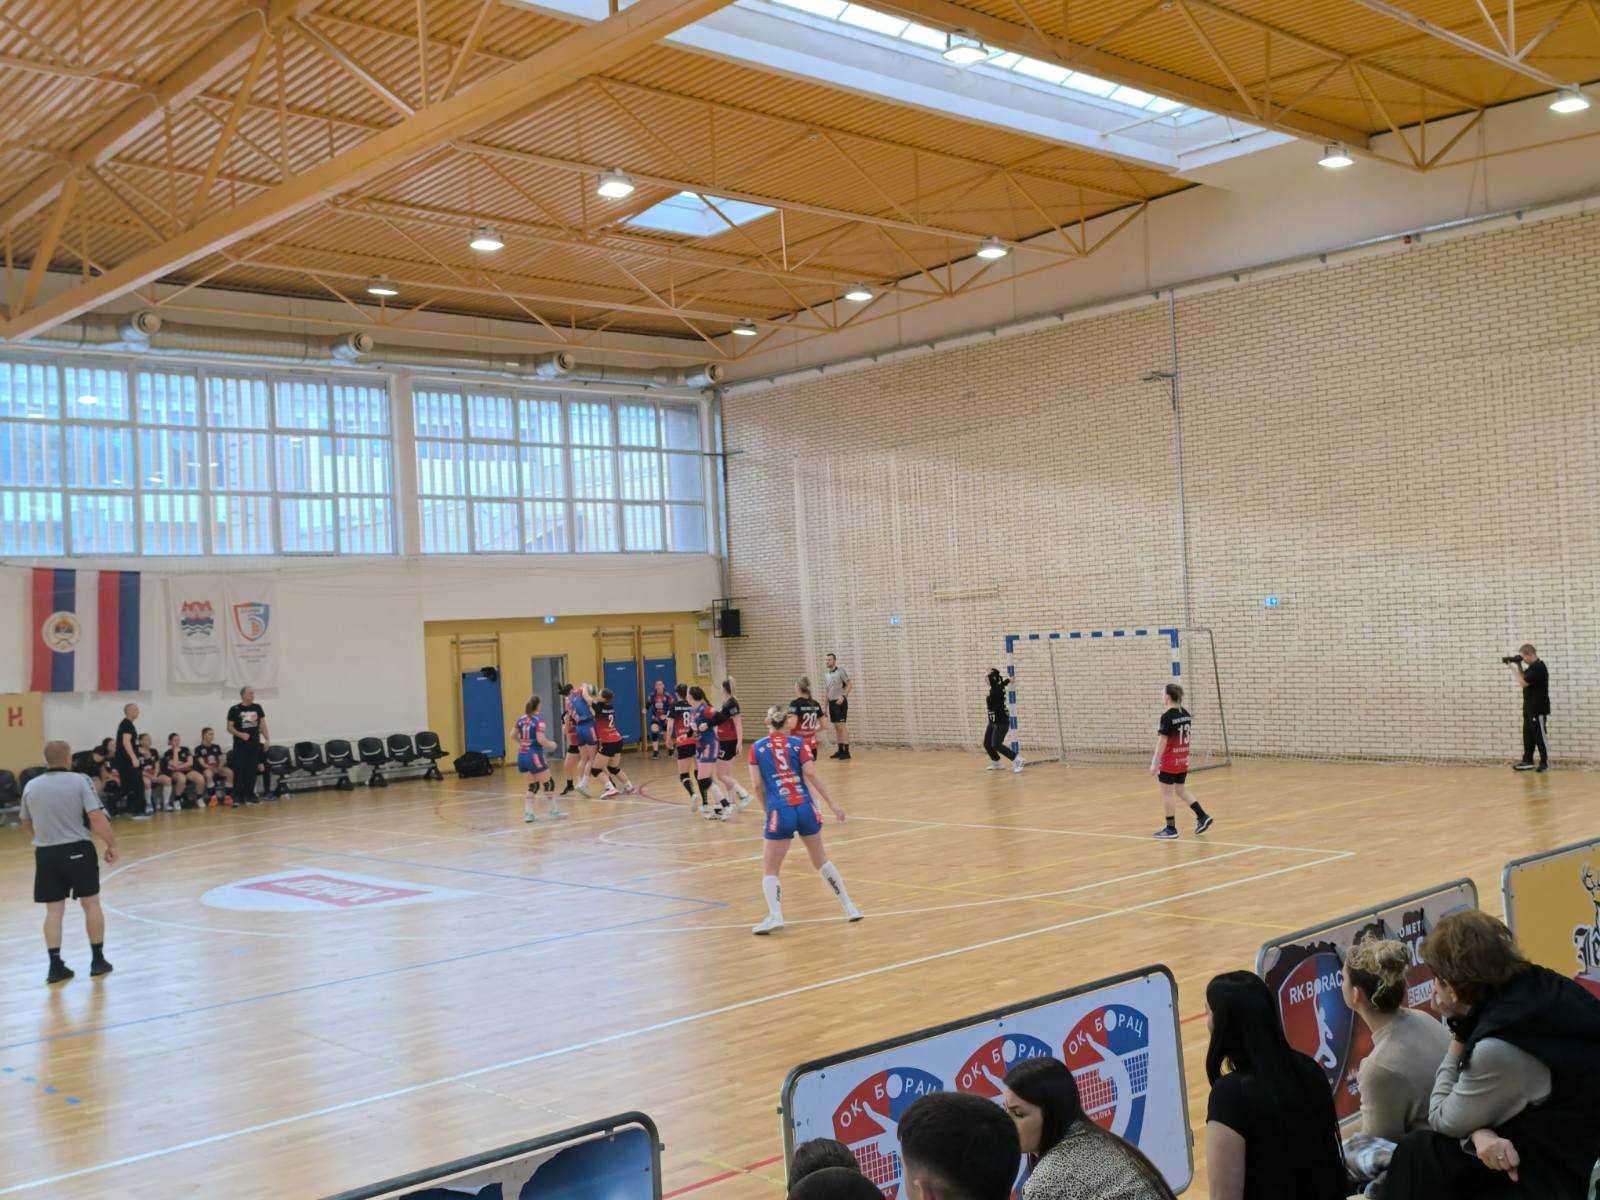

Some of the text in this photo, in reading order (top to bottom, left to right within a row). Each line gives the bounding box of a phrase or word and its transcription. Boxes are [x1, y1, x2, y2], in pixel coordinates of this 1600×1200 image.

[608, 714, 615, 728] 2
[801, 713, 817, 729] 20
[1177, 723, 1190, 745] 13
[775, 748, 788, 771] 5
[1289, 986, 1304, 1005] RK
[1068, 1009, 1144, 1055] ОК БОРАЦ
[962, 1062, 982, 1089] ОК
[840, 1098, 862, 1128] ОК
